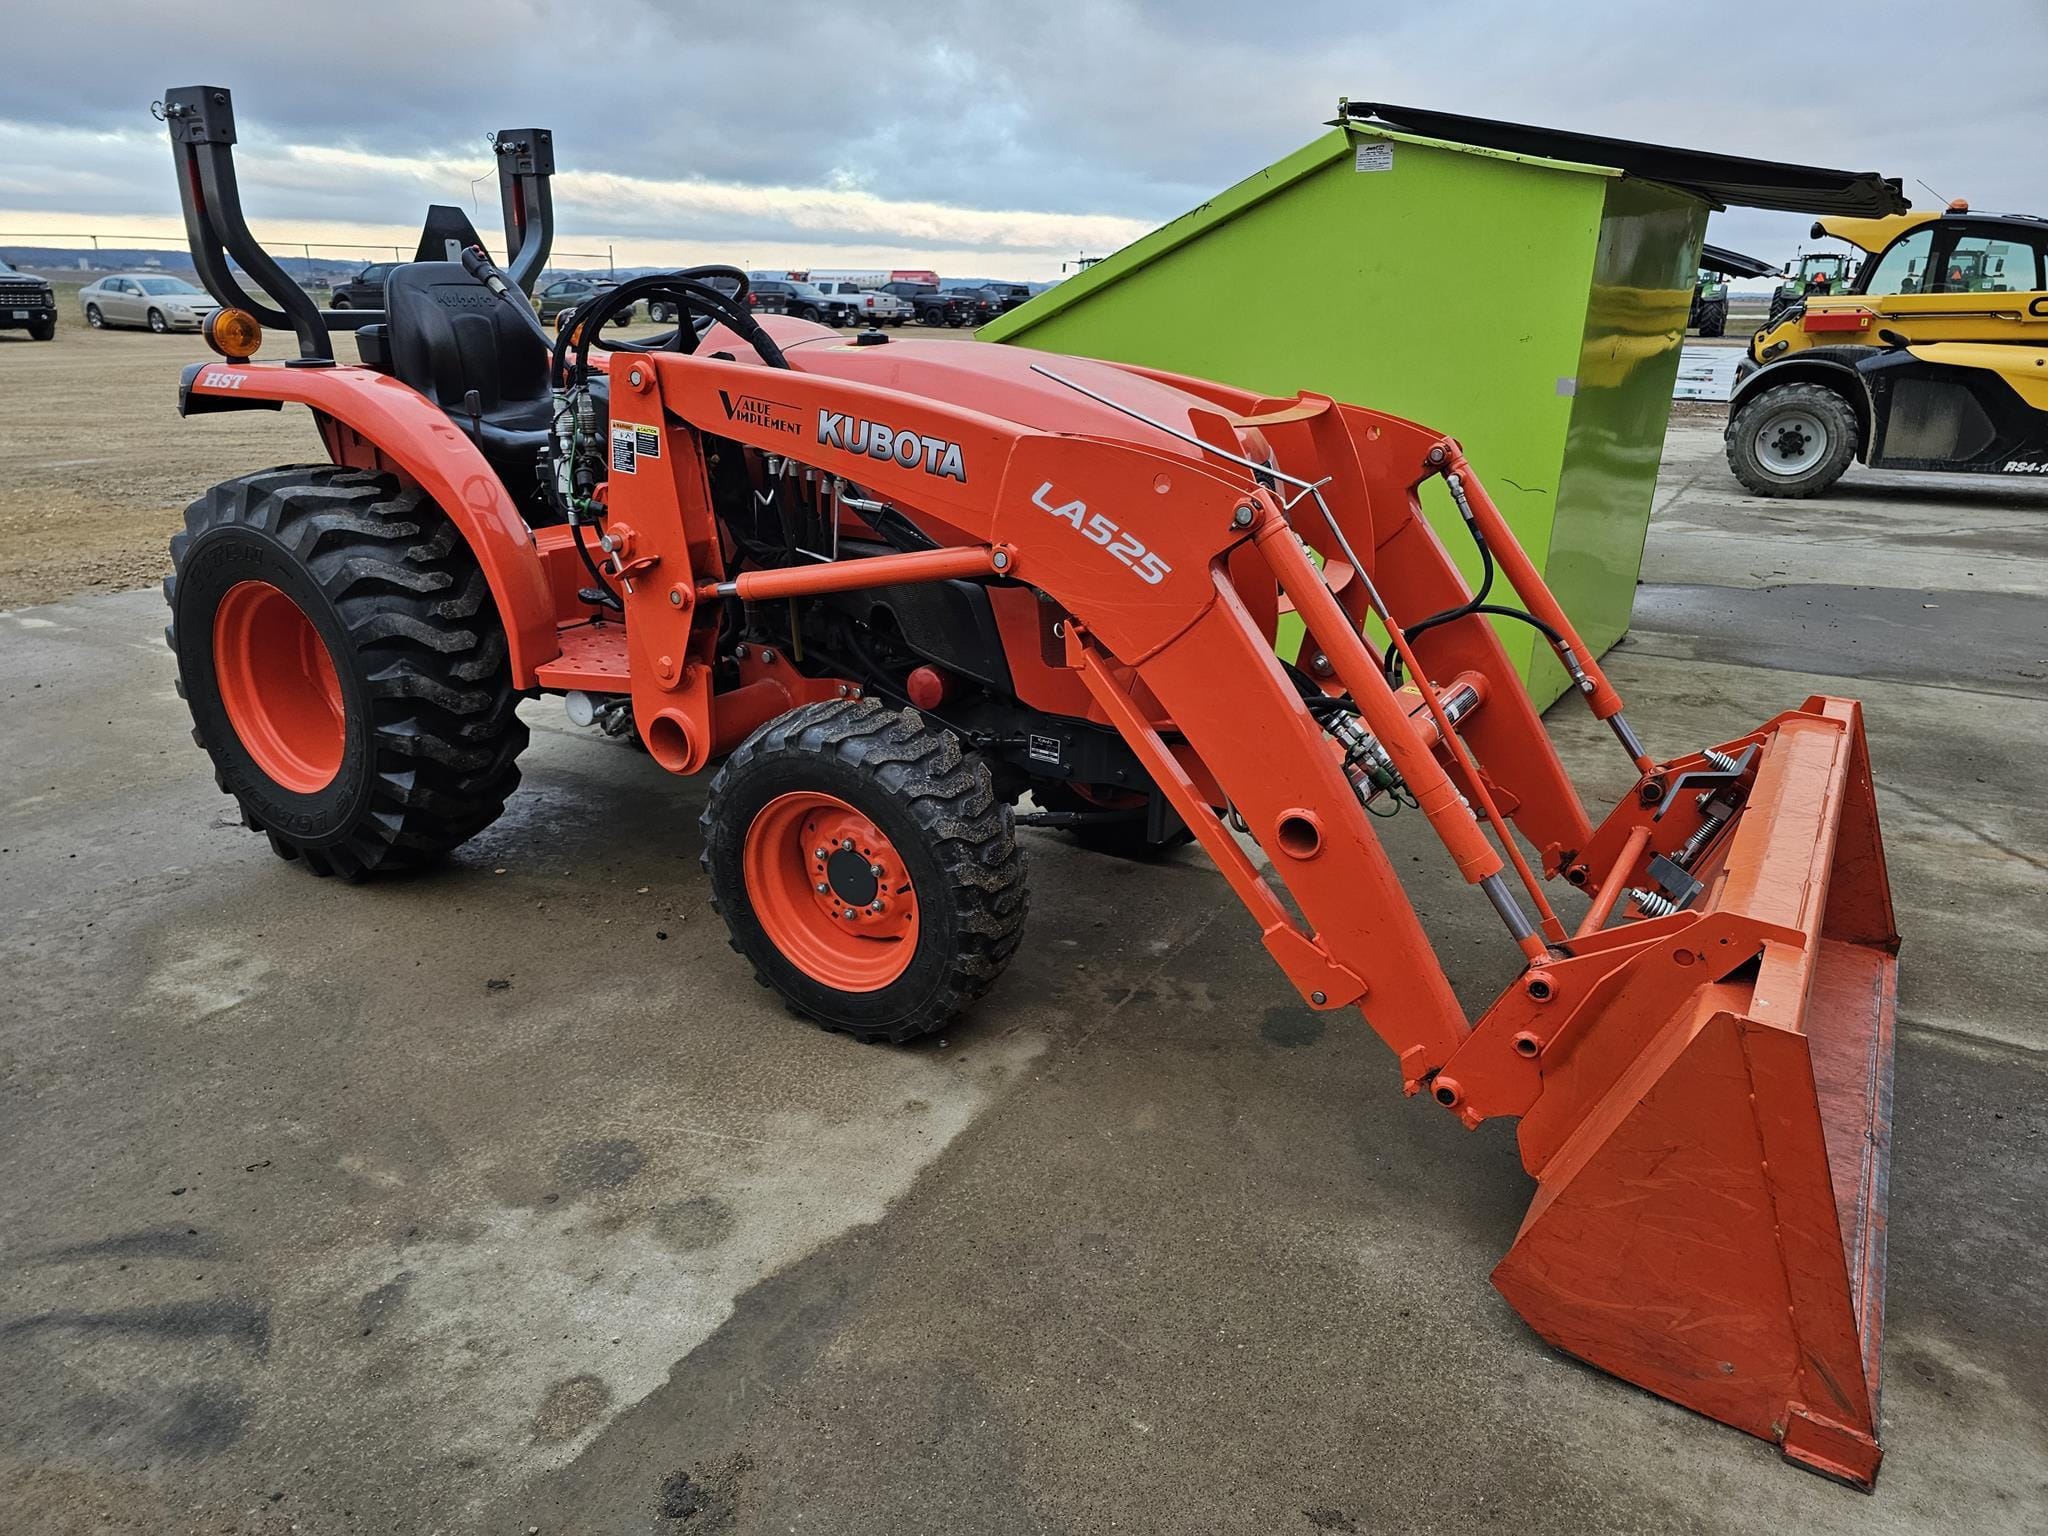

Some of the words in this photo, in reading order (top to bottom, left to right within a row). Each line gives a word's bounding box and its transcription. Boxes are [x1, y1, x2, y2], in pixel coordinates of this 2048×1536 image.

[202, 372, 248, 389] HST
[718, 389, 771, 421] VALUE
[640, 426, 657, 434] CAUTION
[736, 410, 803, 435] IMPLEMENT
[817, 408, 967, 484] KUBOTA
[2002, 461, 2048, 473] RS4-1
[1031, 481, 1172, 585] LA525
